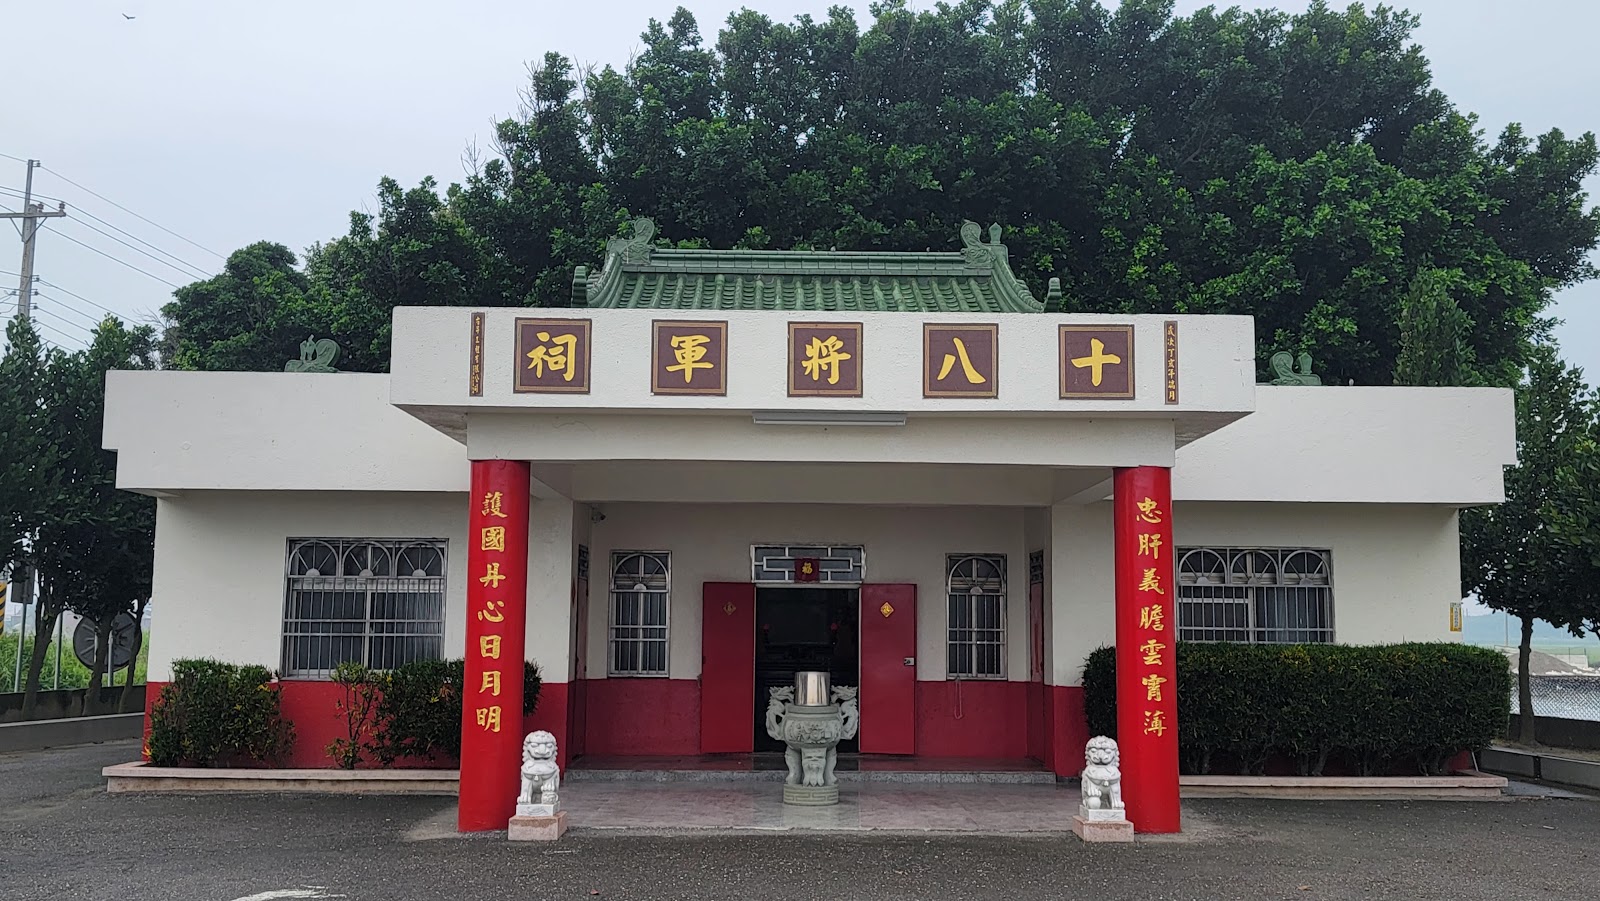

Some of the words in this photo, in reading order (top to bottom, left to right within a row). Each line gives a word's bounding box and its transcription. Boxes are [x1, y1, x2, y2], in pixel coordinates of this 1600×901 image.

[476, 491, 508, 733] 護國丹心日月明
[1136, 496, 1168, 737] 忠肝義膽雲霄薄
